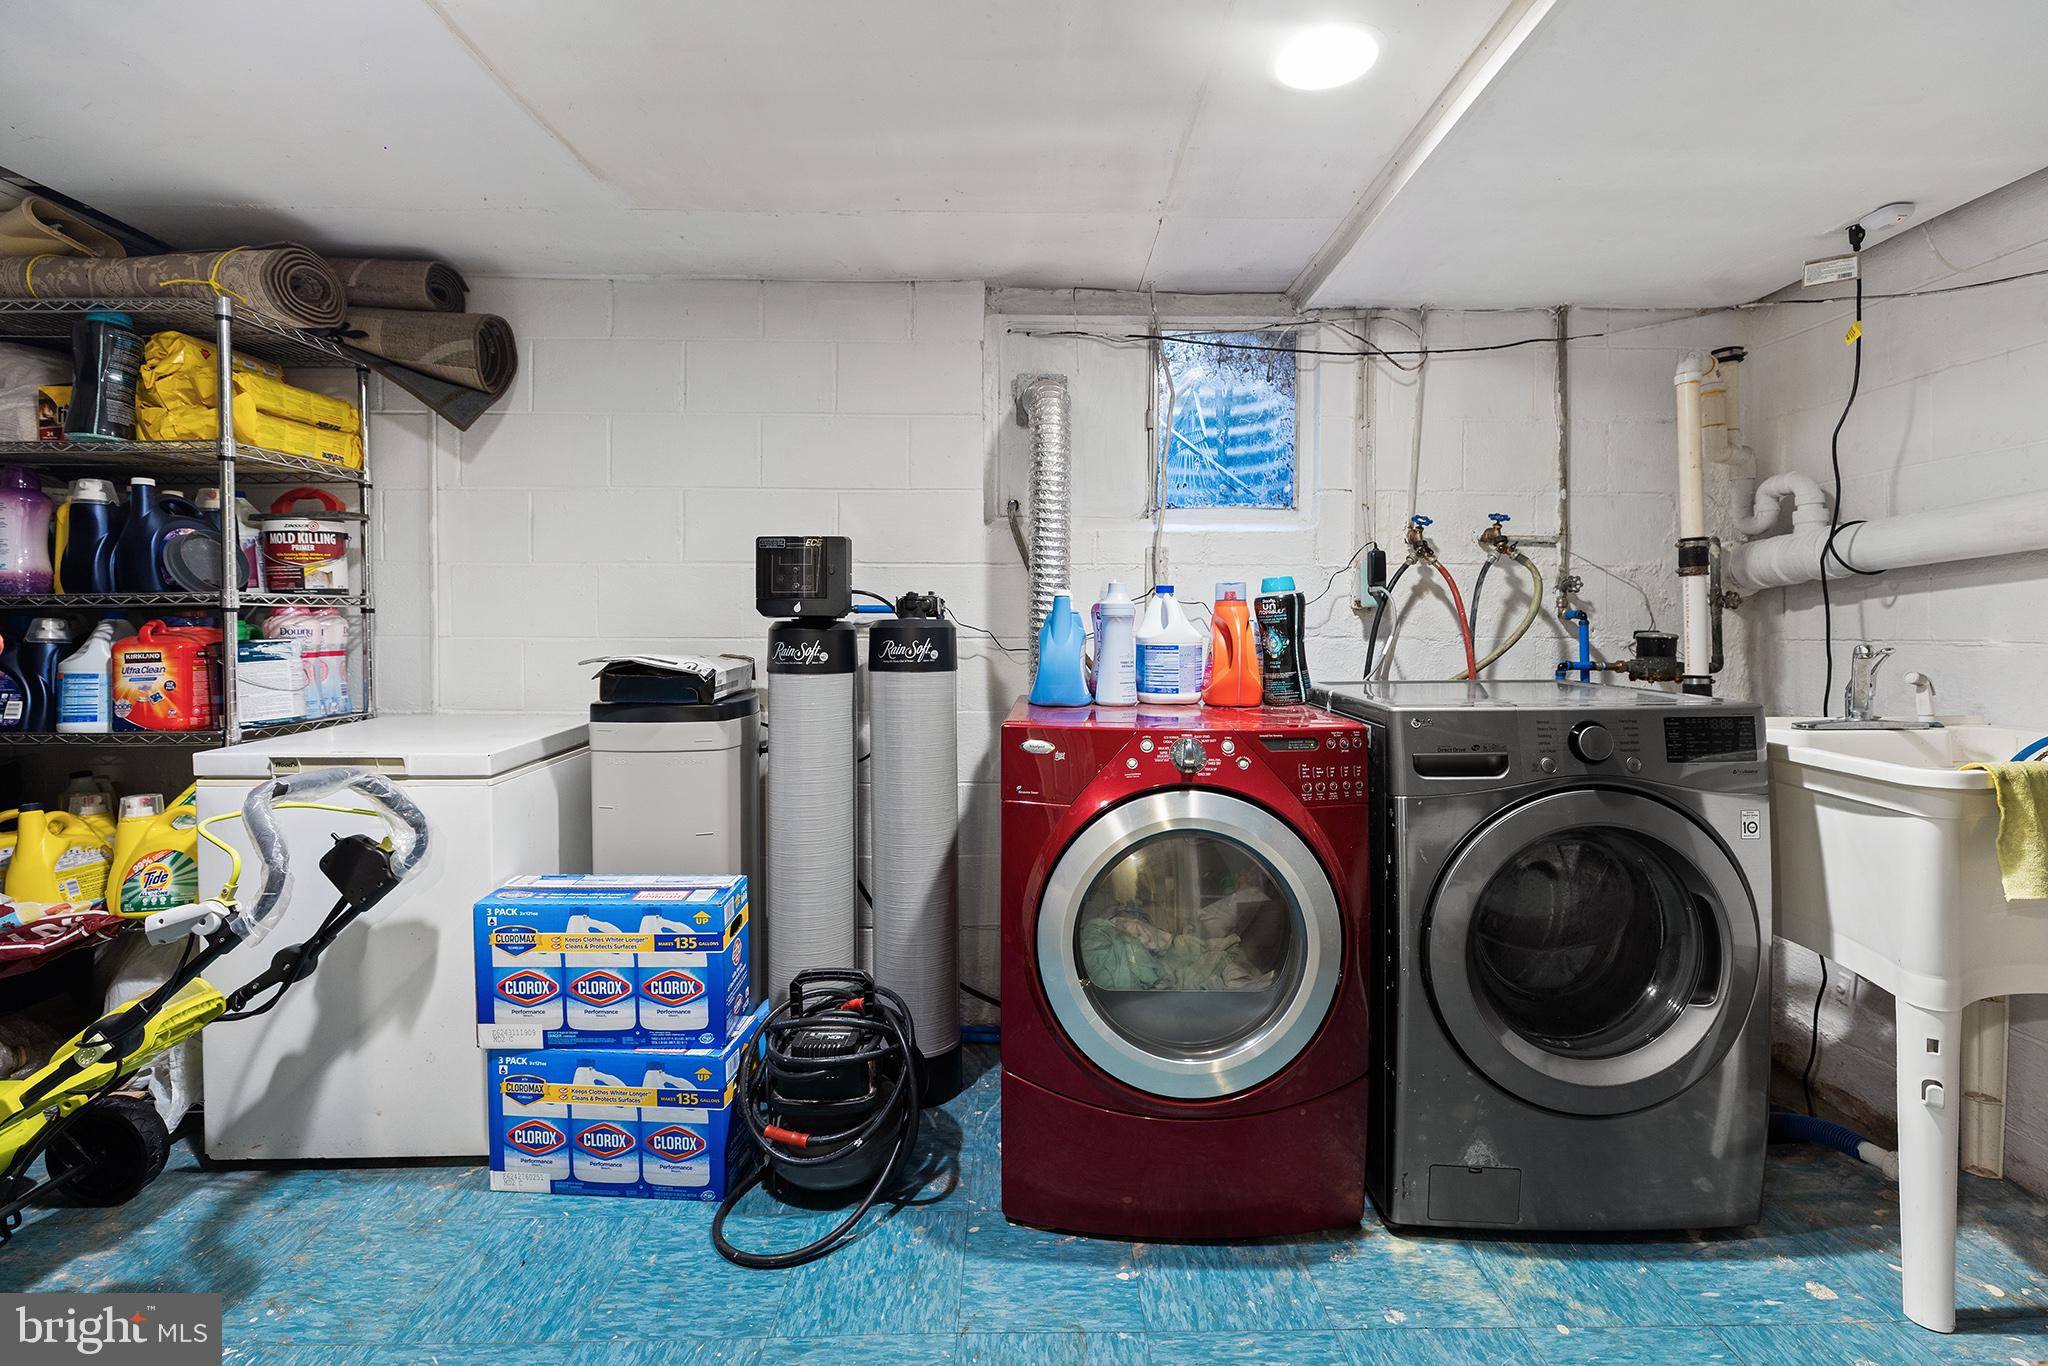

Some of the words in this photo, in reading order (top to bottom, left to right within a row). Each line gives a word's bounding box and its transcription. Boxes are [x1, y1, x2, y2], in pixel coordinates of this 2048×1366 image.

[269, 532, 296, 544] MOLD
[297, 532, 336, 544] KILLING
[280, 626, 313, 638] Downy
[1743, 821, 1758, 834] 10
[144, 870, 169, 889] Tide
[496, 934, 536, 943] CLOROMAX
[674, 937, 697, 949] 135
[505, 980, 550, 995] CLOROX
[578, 980, 623, 995] CLOROX
[650, 980, 696, 995] CLOROX
[506, 1057, 528, 1065] PACK
[506, 1083, 544, 1093] CLOROMAX
[676, 1093, 699, 1105] 135
[514, 1130, 557, 1145] CLOROX
[583, 1133, 626, 1148] CLOROX
[654, 1136, 697, 1150] CLOROX
